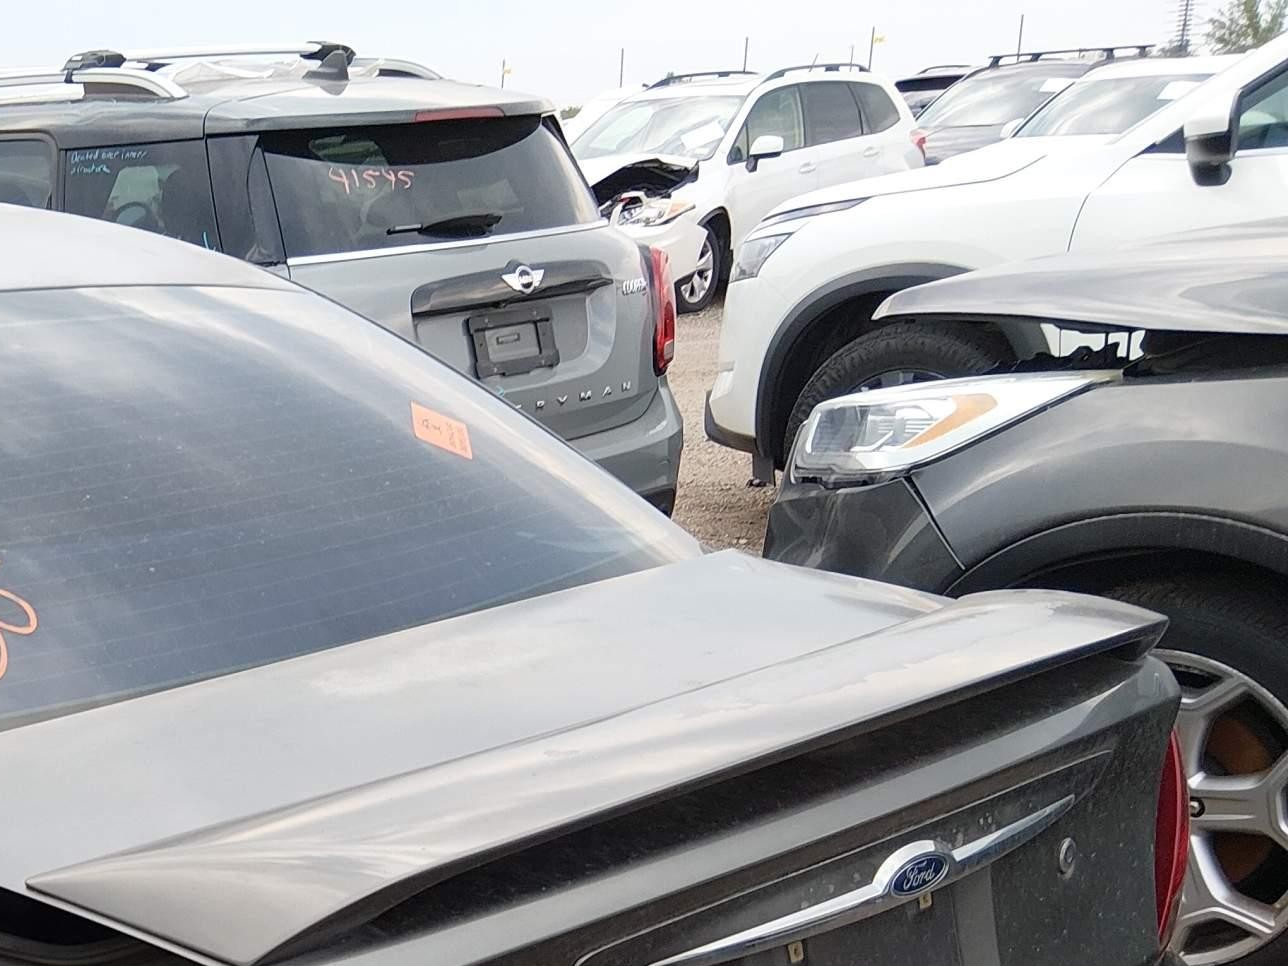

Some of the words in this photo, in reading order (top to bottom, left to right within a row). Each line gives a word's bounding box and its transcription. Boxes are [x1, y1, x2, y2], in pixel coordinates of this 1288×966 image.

[328, 167, 415, 194] 41545
[515, 380, 631, 409] RYMAN
[903, 860, 936, 890] Ford
